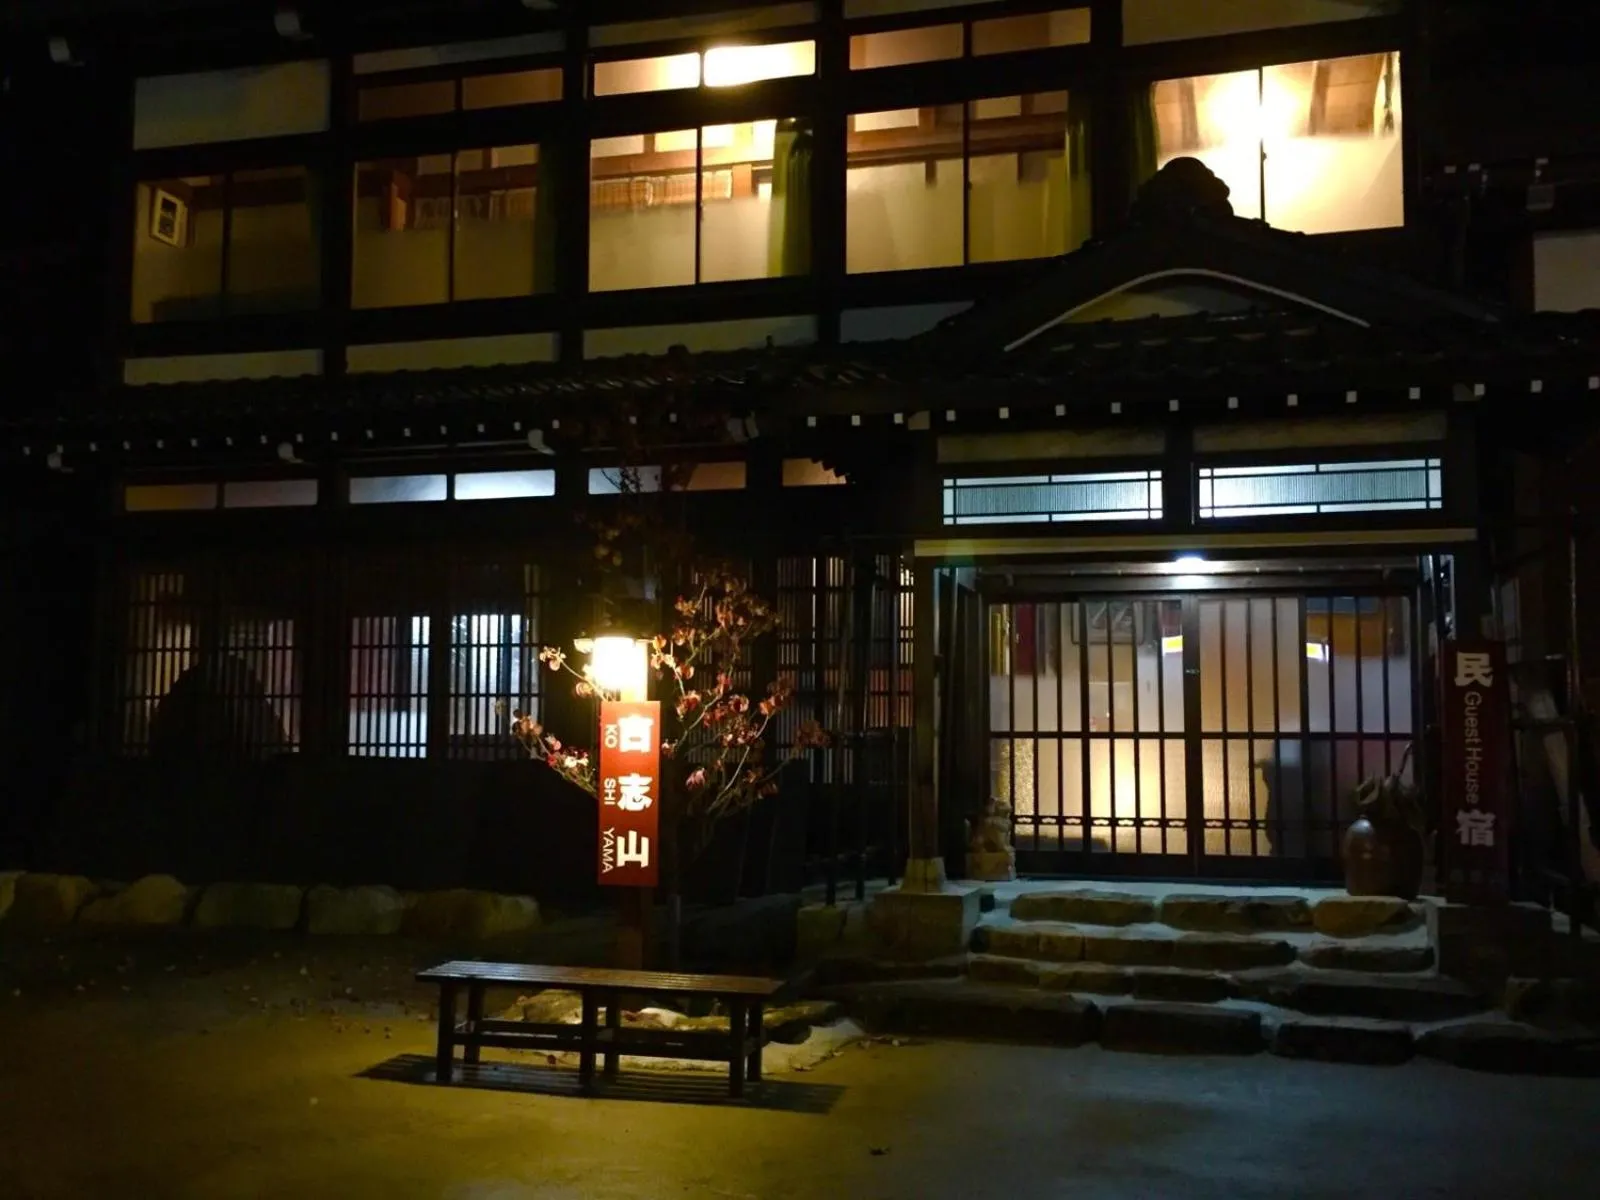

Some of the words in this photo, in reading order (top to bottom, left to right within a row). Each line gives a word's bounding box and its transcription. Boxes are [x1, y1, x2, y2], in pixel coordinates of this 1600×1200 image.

[1454, 652, 1494, 687] 民
[604, 724, 618, 748] KO
[1463, 691, 1483, 744] Guest
[603, 777, 616, 805] SHI
[1464, 747, 1483, 804] House
[1456, 809, 1497, 847] 宿
[602, 827, 615, 873] YAMA
